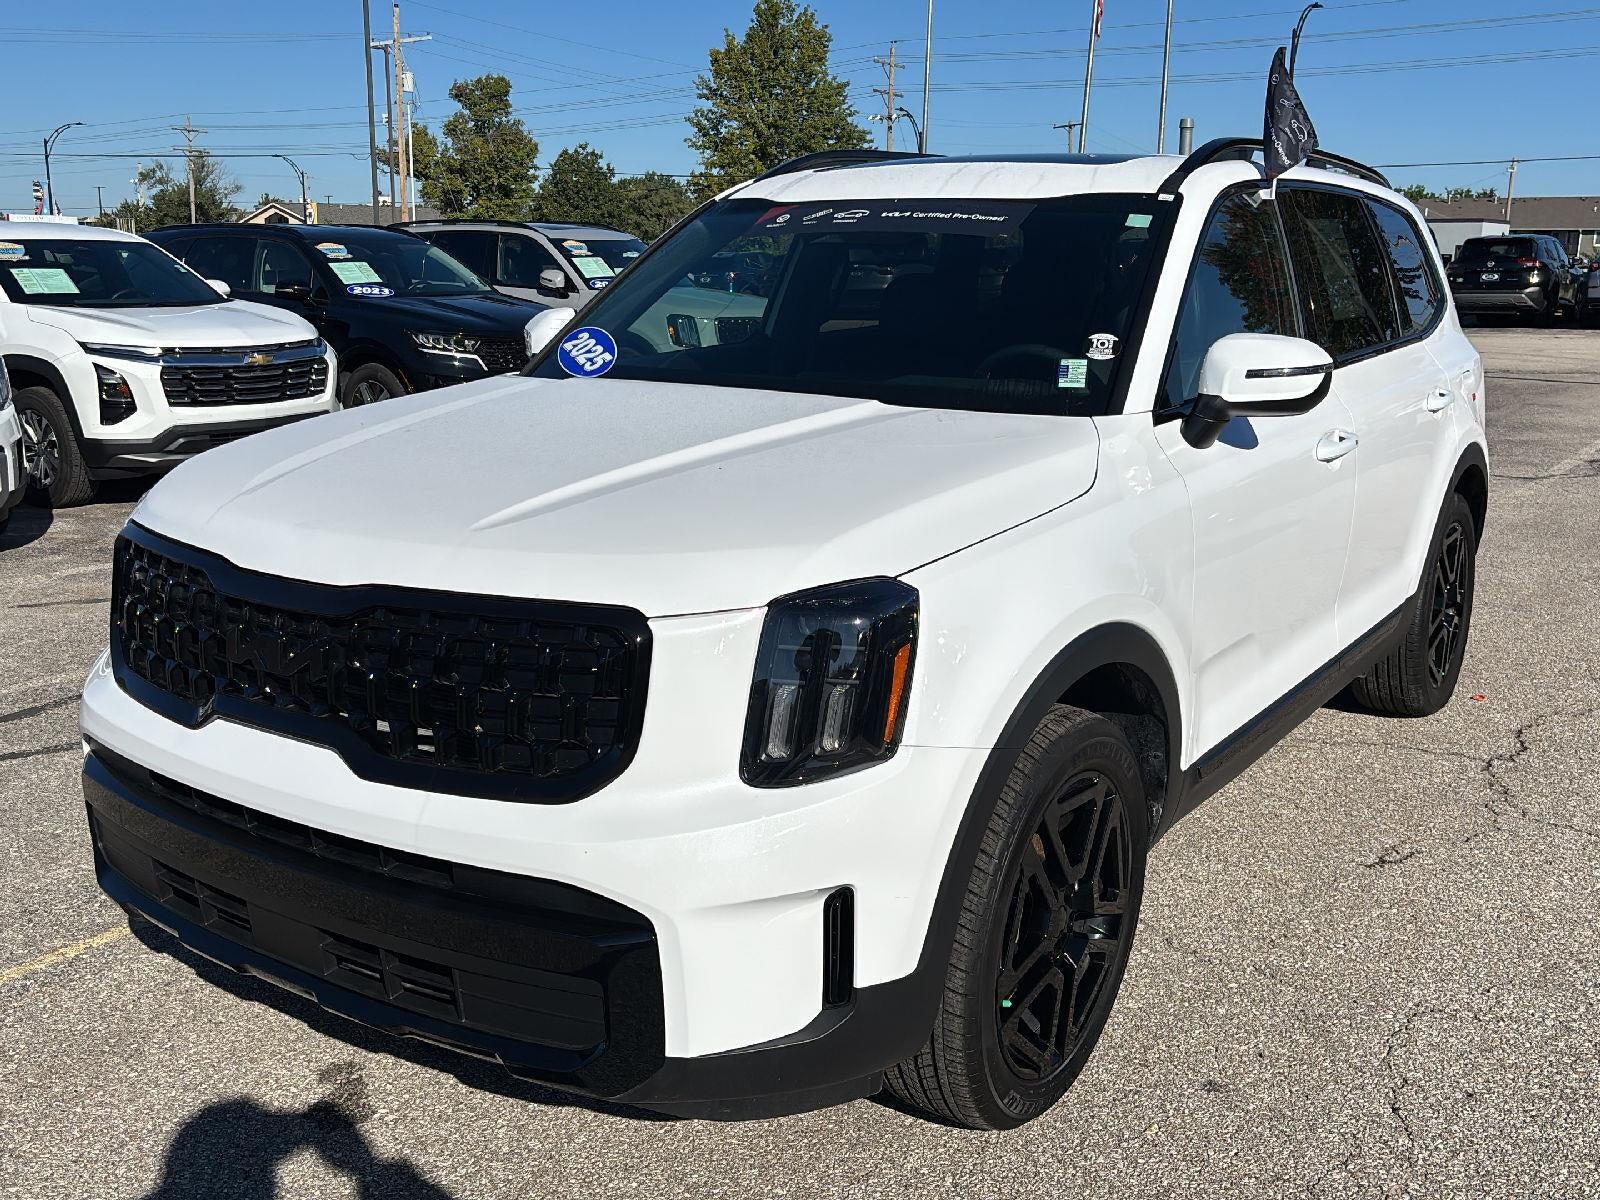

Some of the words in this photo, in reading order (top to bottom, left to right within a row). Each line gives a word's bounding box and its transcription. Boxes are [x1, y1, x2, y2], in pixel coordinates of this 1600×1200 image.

[912, 211, 953, 219] Certified
[353, 286, 390, 295] 2023
[562, 332, 613, 372] 2025
